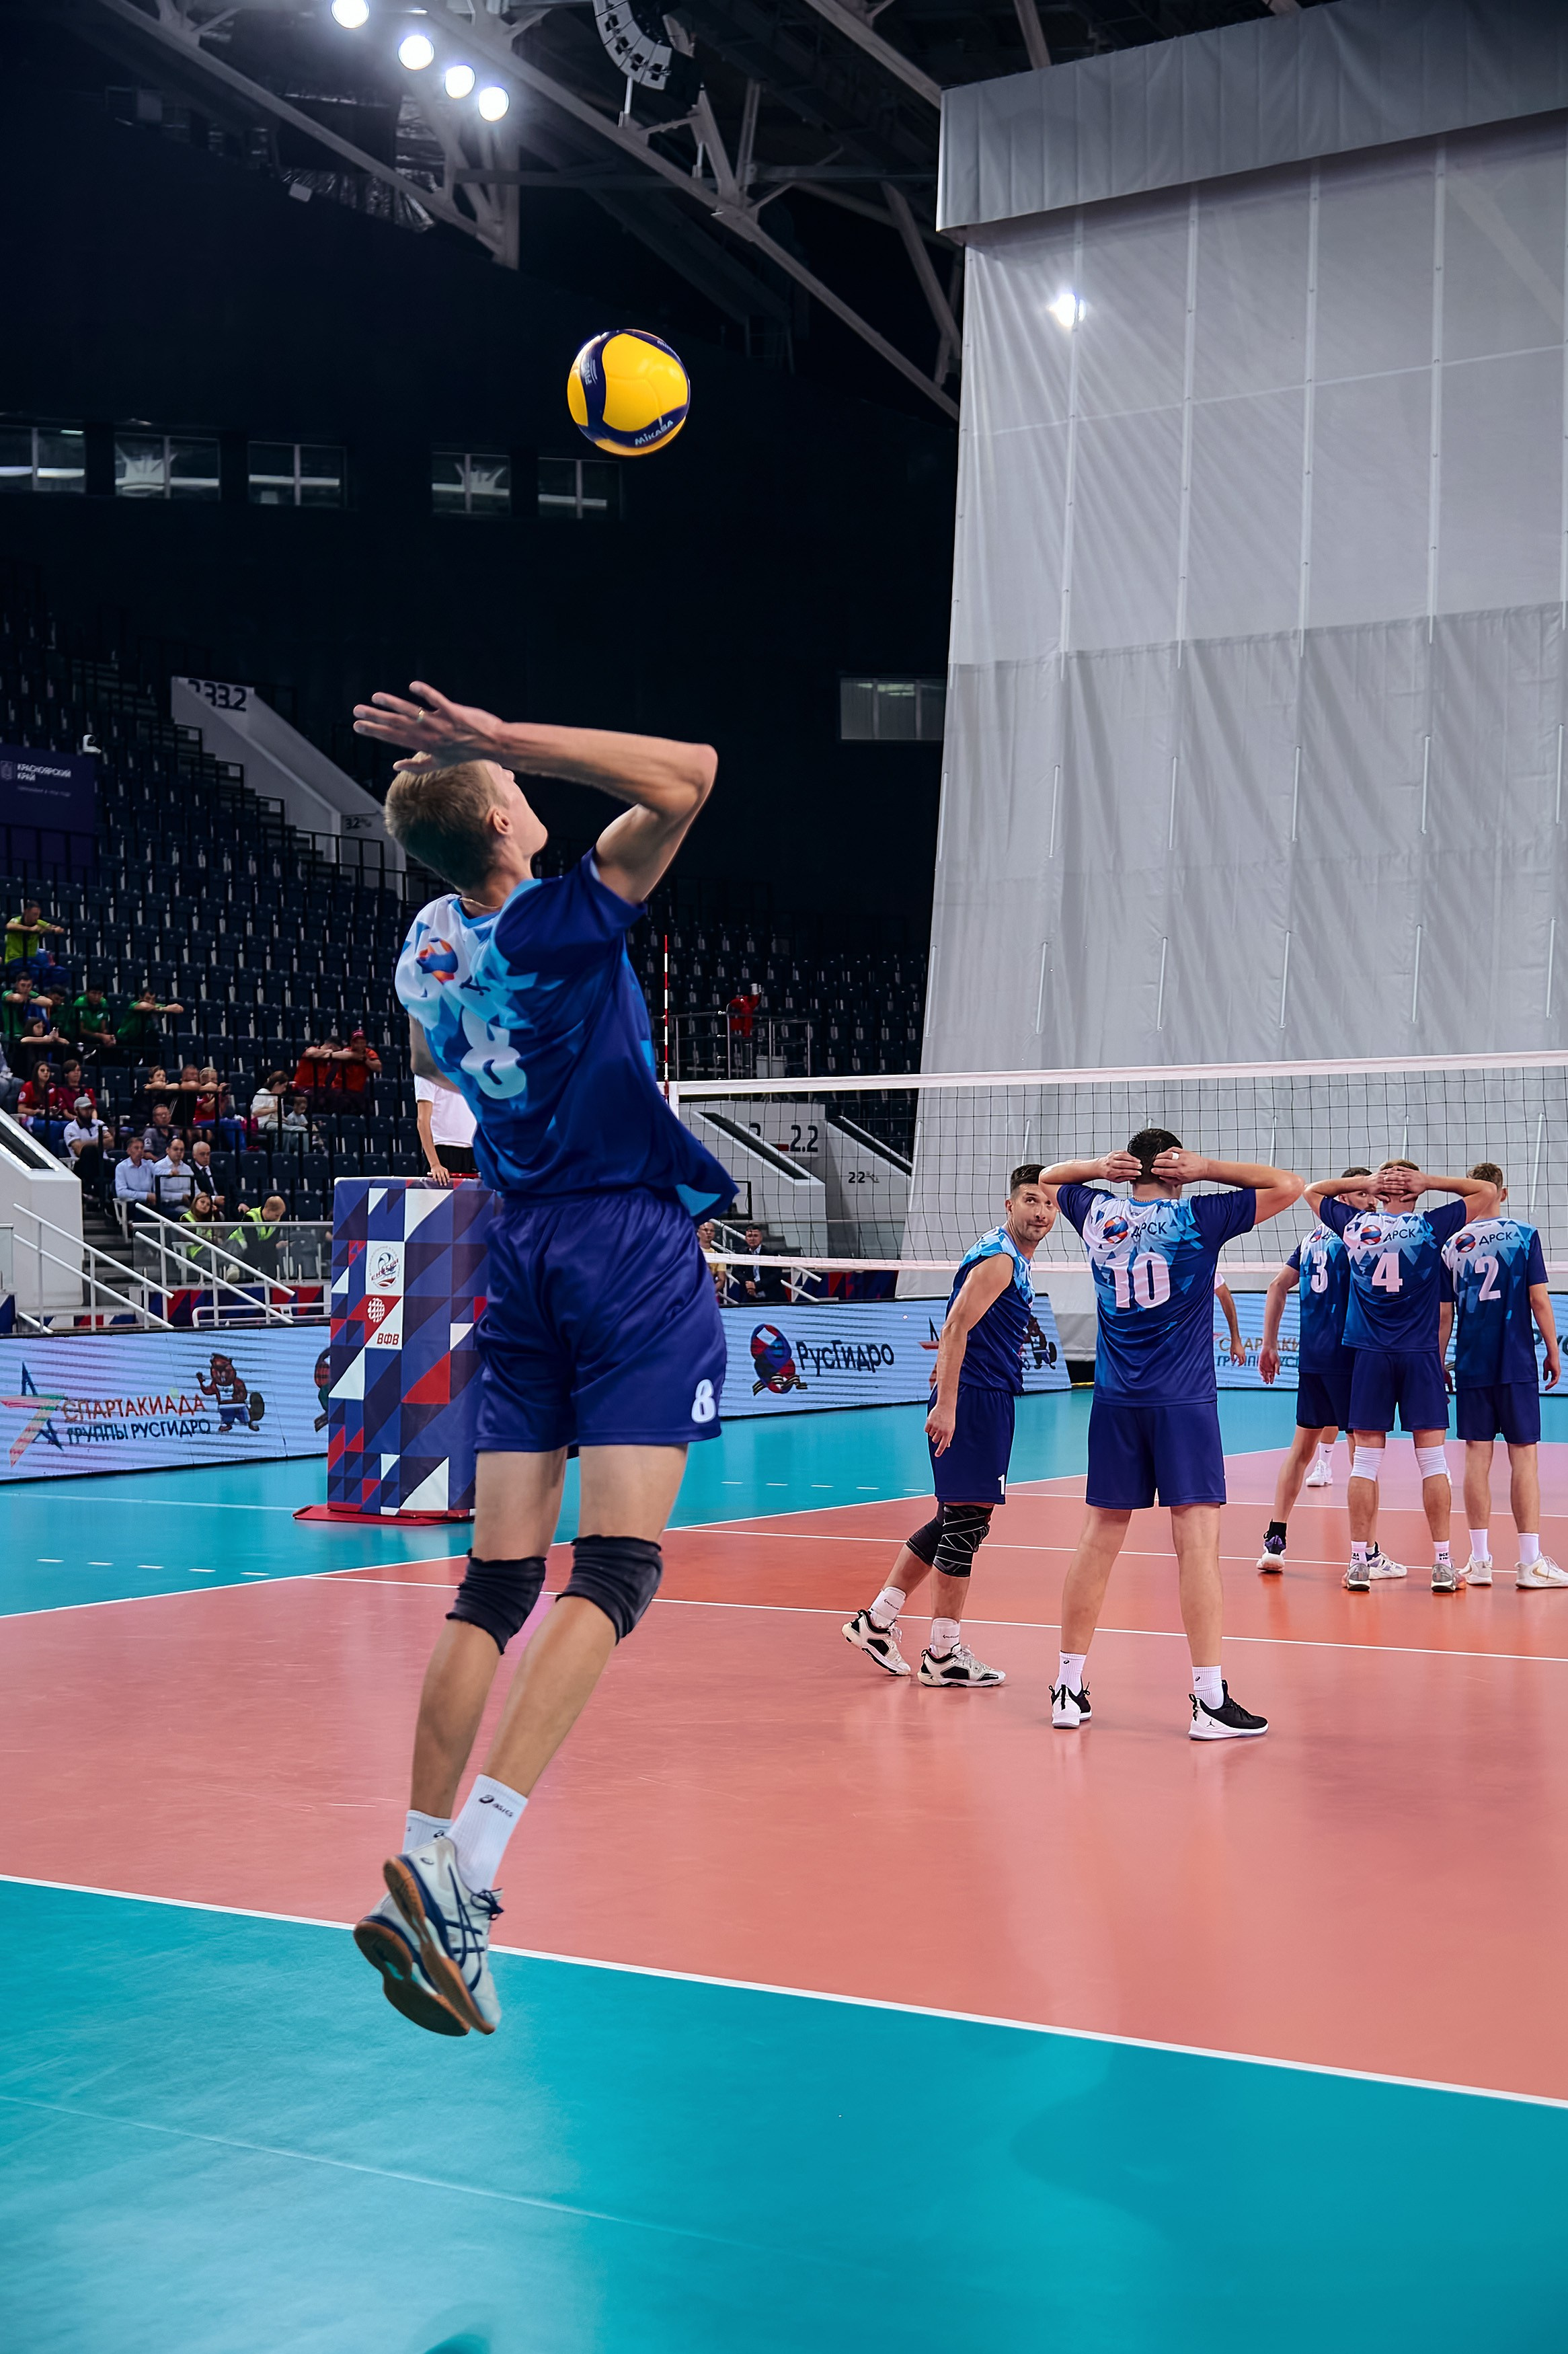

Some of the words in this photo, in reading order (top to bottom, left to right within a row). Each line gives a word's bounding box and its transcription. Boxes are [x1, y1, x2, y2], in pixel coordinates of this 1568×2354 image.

[460, 1007, 526, 1100] 8
[848, 1171, 865, 1183] 22
[1103, 1252, 1171, 1309] 10
[1310, 1250, 1329, 1293] 3
[1372, 1252, 1403, 1293] 4
[1475, 1255, 1501, 1301] 2
[377, 1332, 399, 1345] ВФВ
[795, 1339, 895, 1377] РусГидро
[62, 1394, 206, 1422] СПАРТАКИАДА
[691, 1379, 717, 1424] 8
[67, 1424, 129, 1444] ГРУППЫ
[130, 1418, 211, 1439] РУСГИДРО
[998, 1474, 1005, 1495] 1
